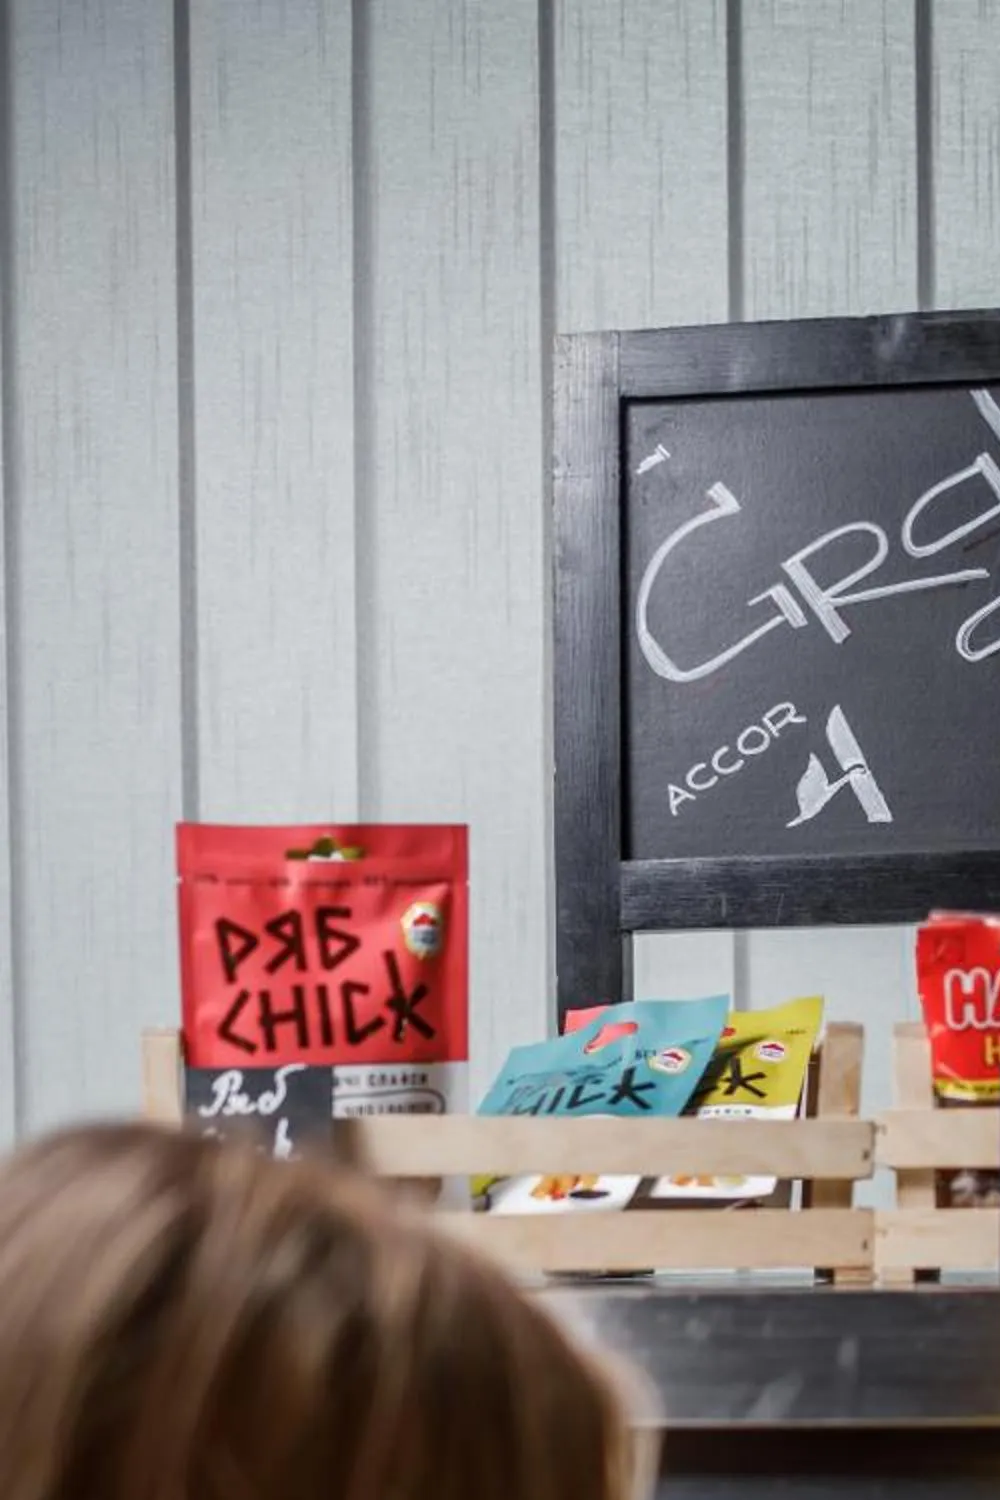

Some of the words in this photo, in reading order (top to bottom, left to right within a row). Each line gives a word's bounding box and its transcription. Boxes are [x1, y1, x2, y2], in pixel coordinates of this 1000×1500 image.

[667, 702, 807, 816] ACCOR
[214, 905, 361, 985] РЯБ
[217, 949, 437, 1055] CHICK
